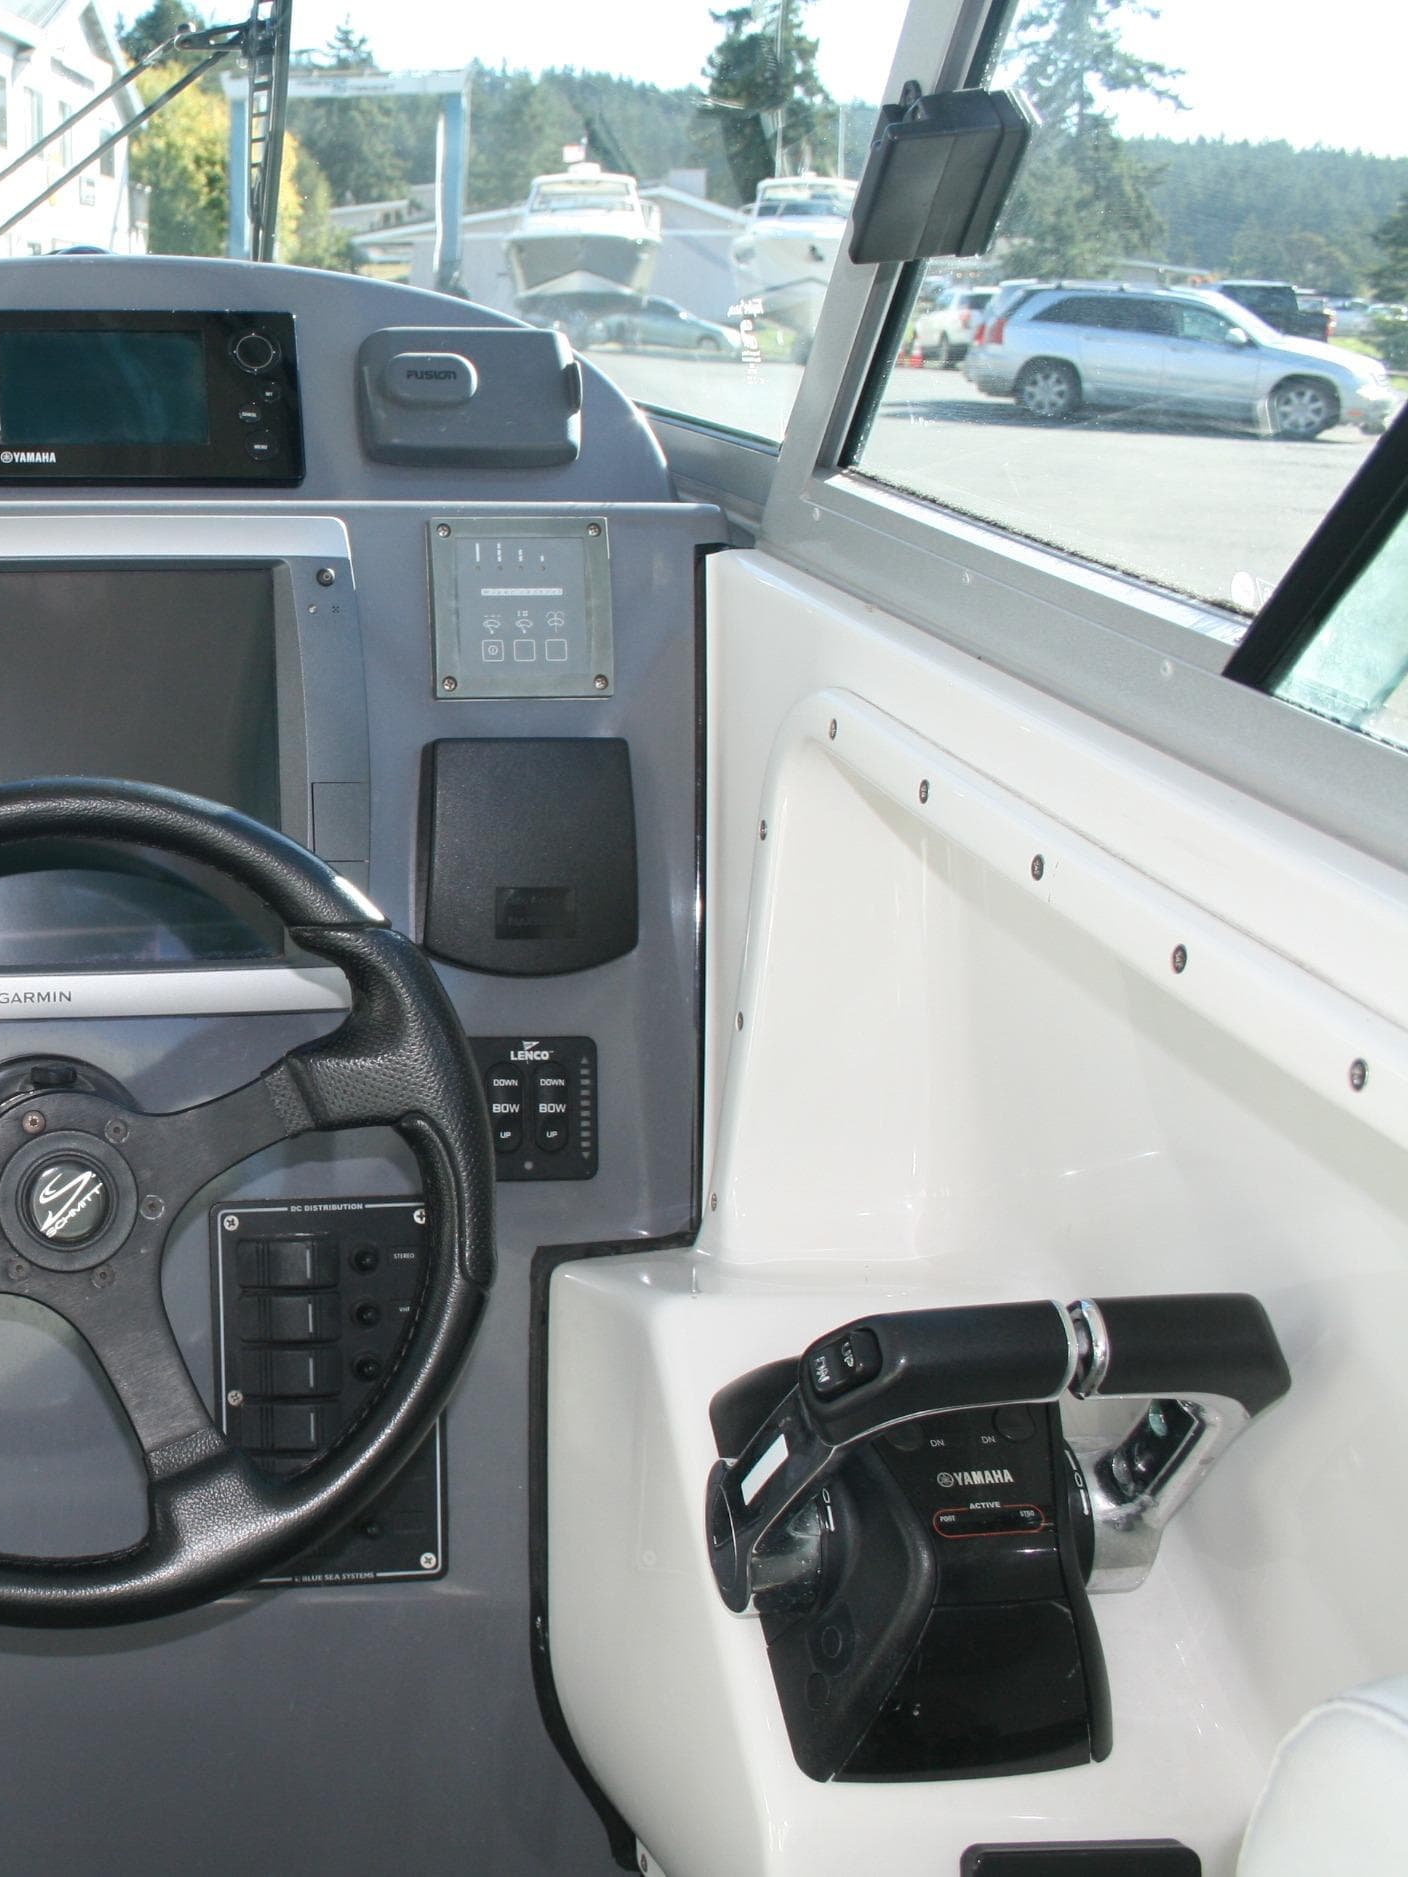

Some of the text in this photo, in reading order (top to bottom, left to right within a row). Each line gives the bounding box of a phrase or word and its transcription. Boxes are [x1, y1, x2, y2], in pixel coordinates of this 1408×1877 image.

[406, 370, 457, 380] FUSION
[13, 451, 57, 463] YAMAHA
[509, 1050, 550, 1061] LENCO
[493, 1078, 518, 1087] DOWN
[540, 1078, 565, 1087] DOWN
[492, 1103, 520, 1113] BOW
[539, 1103, 566, 1113] BOW
[499, 1131, 511, 1139] UP
[546, 1130, 558, 1138] UP
[304, 1203, 363, 1212] DISTRIBUTION
[953, 1469, 1014, 1486] YAMAHA
[969, 1501, 1001, 1510] ACTIVE
[939, 1514, 956, 1522] PORT
[301, 1571, 375, 1582] BLUE SEA SYSTEMS
